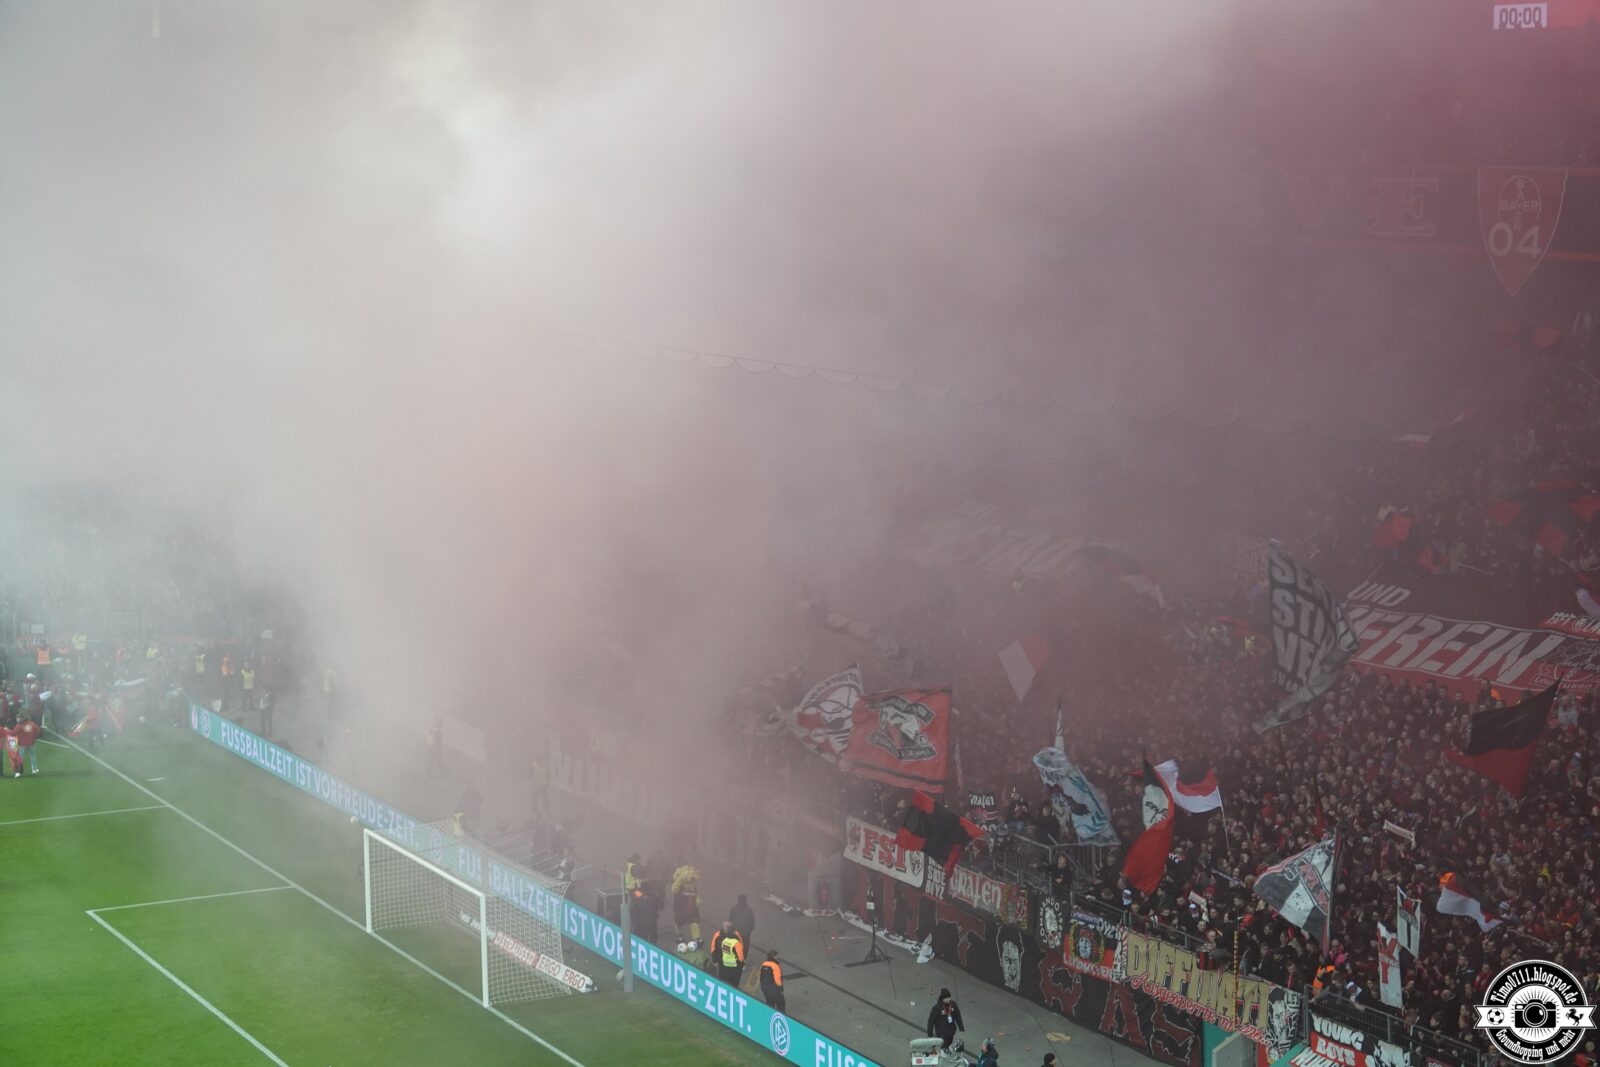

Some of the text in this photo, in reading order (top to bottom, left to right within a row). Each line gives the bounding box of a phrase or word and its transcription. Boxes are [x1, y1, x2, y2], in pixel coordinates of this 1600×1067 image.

[1488, 221, 1543, 259] 04
[1347, 581, 1411, 607] UND
[1347, 606, 1567, 684] EREIN
[221, 722, 293, 778] FUSSBALLZEIT
[295, 760, 312, 788] IST
[564, 903, 587, 942] IST
[539, 956, 561, 976] ERGO
[562, 968, 586, 989] ERGO
[1309, 1009, 1365, 1051] YOUNG
